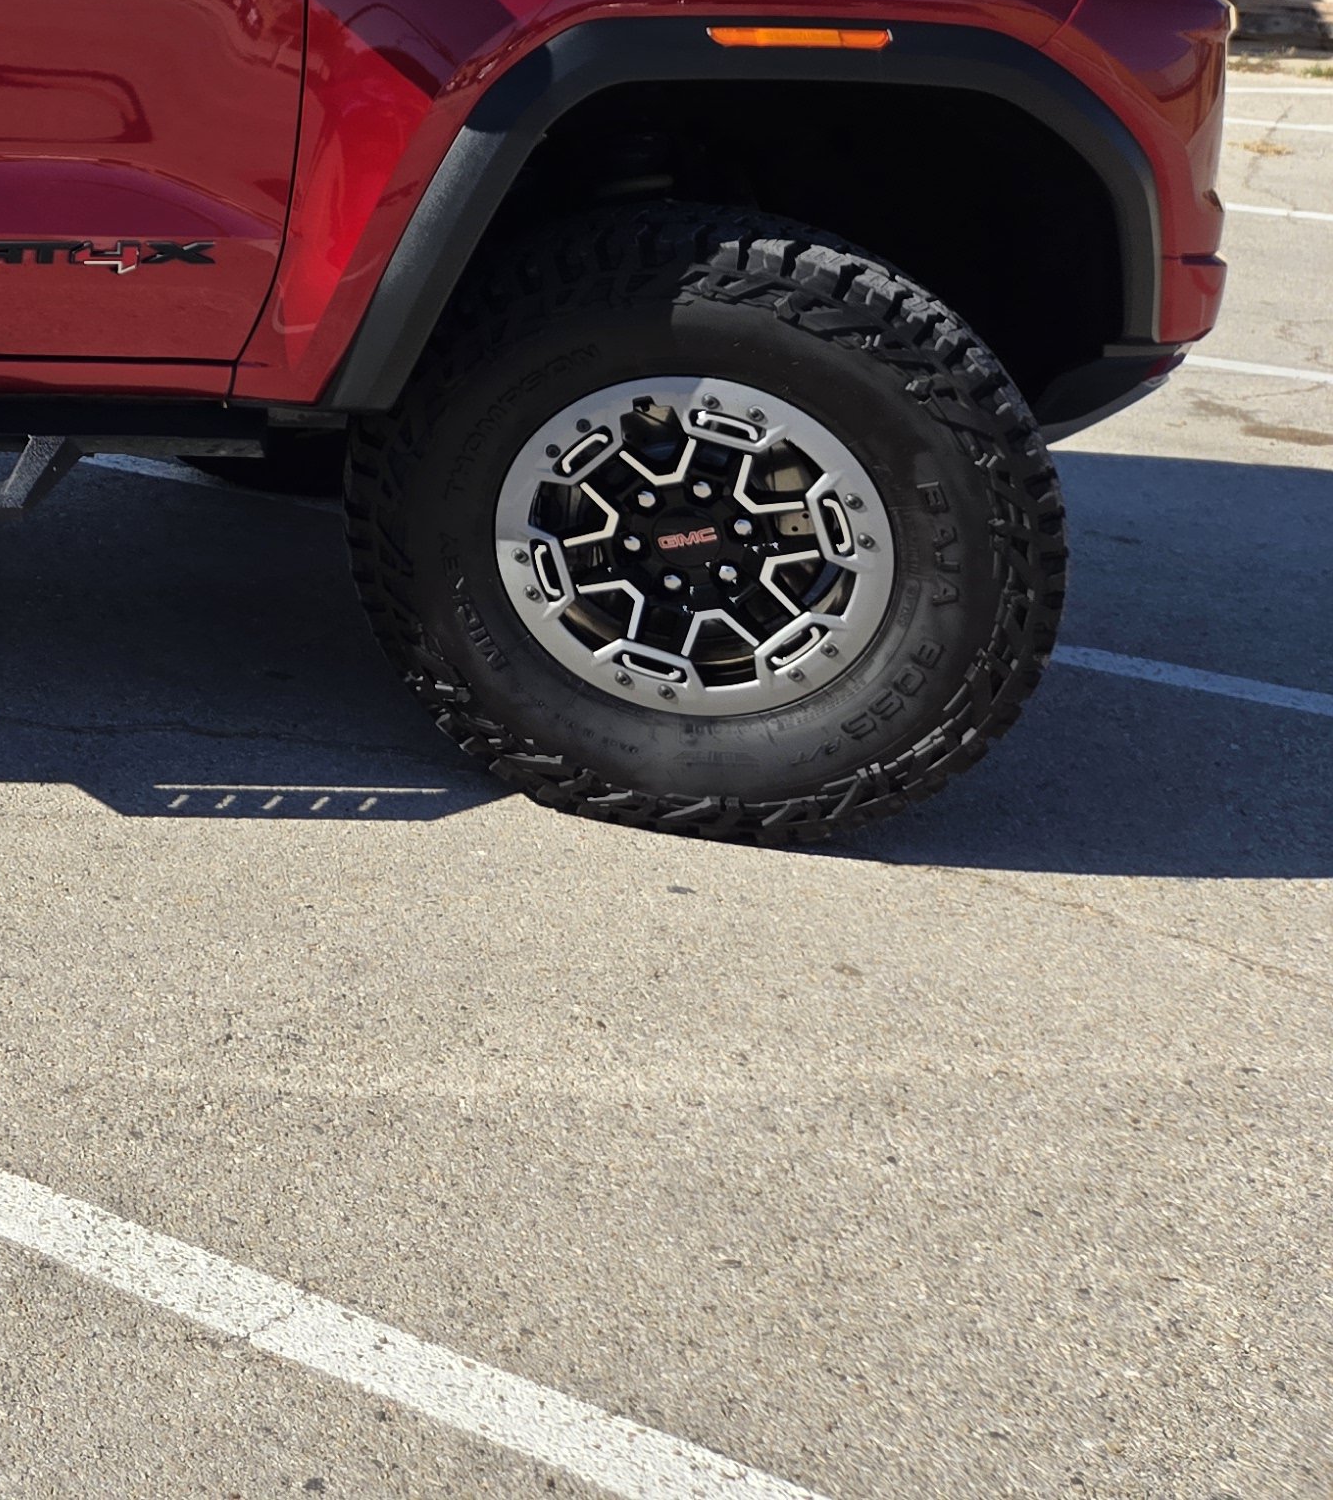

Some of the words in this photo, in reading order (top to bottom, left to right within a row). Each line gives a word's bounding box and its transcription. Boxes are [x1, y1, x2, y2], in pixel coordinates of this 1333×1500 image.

[445, 341, 601, 498] THOMPSON
[658, 526, 718, 550] GMC
[916, 480, 961, 607] BAJA
[840, 637, 948, 741] BOSS
